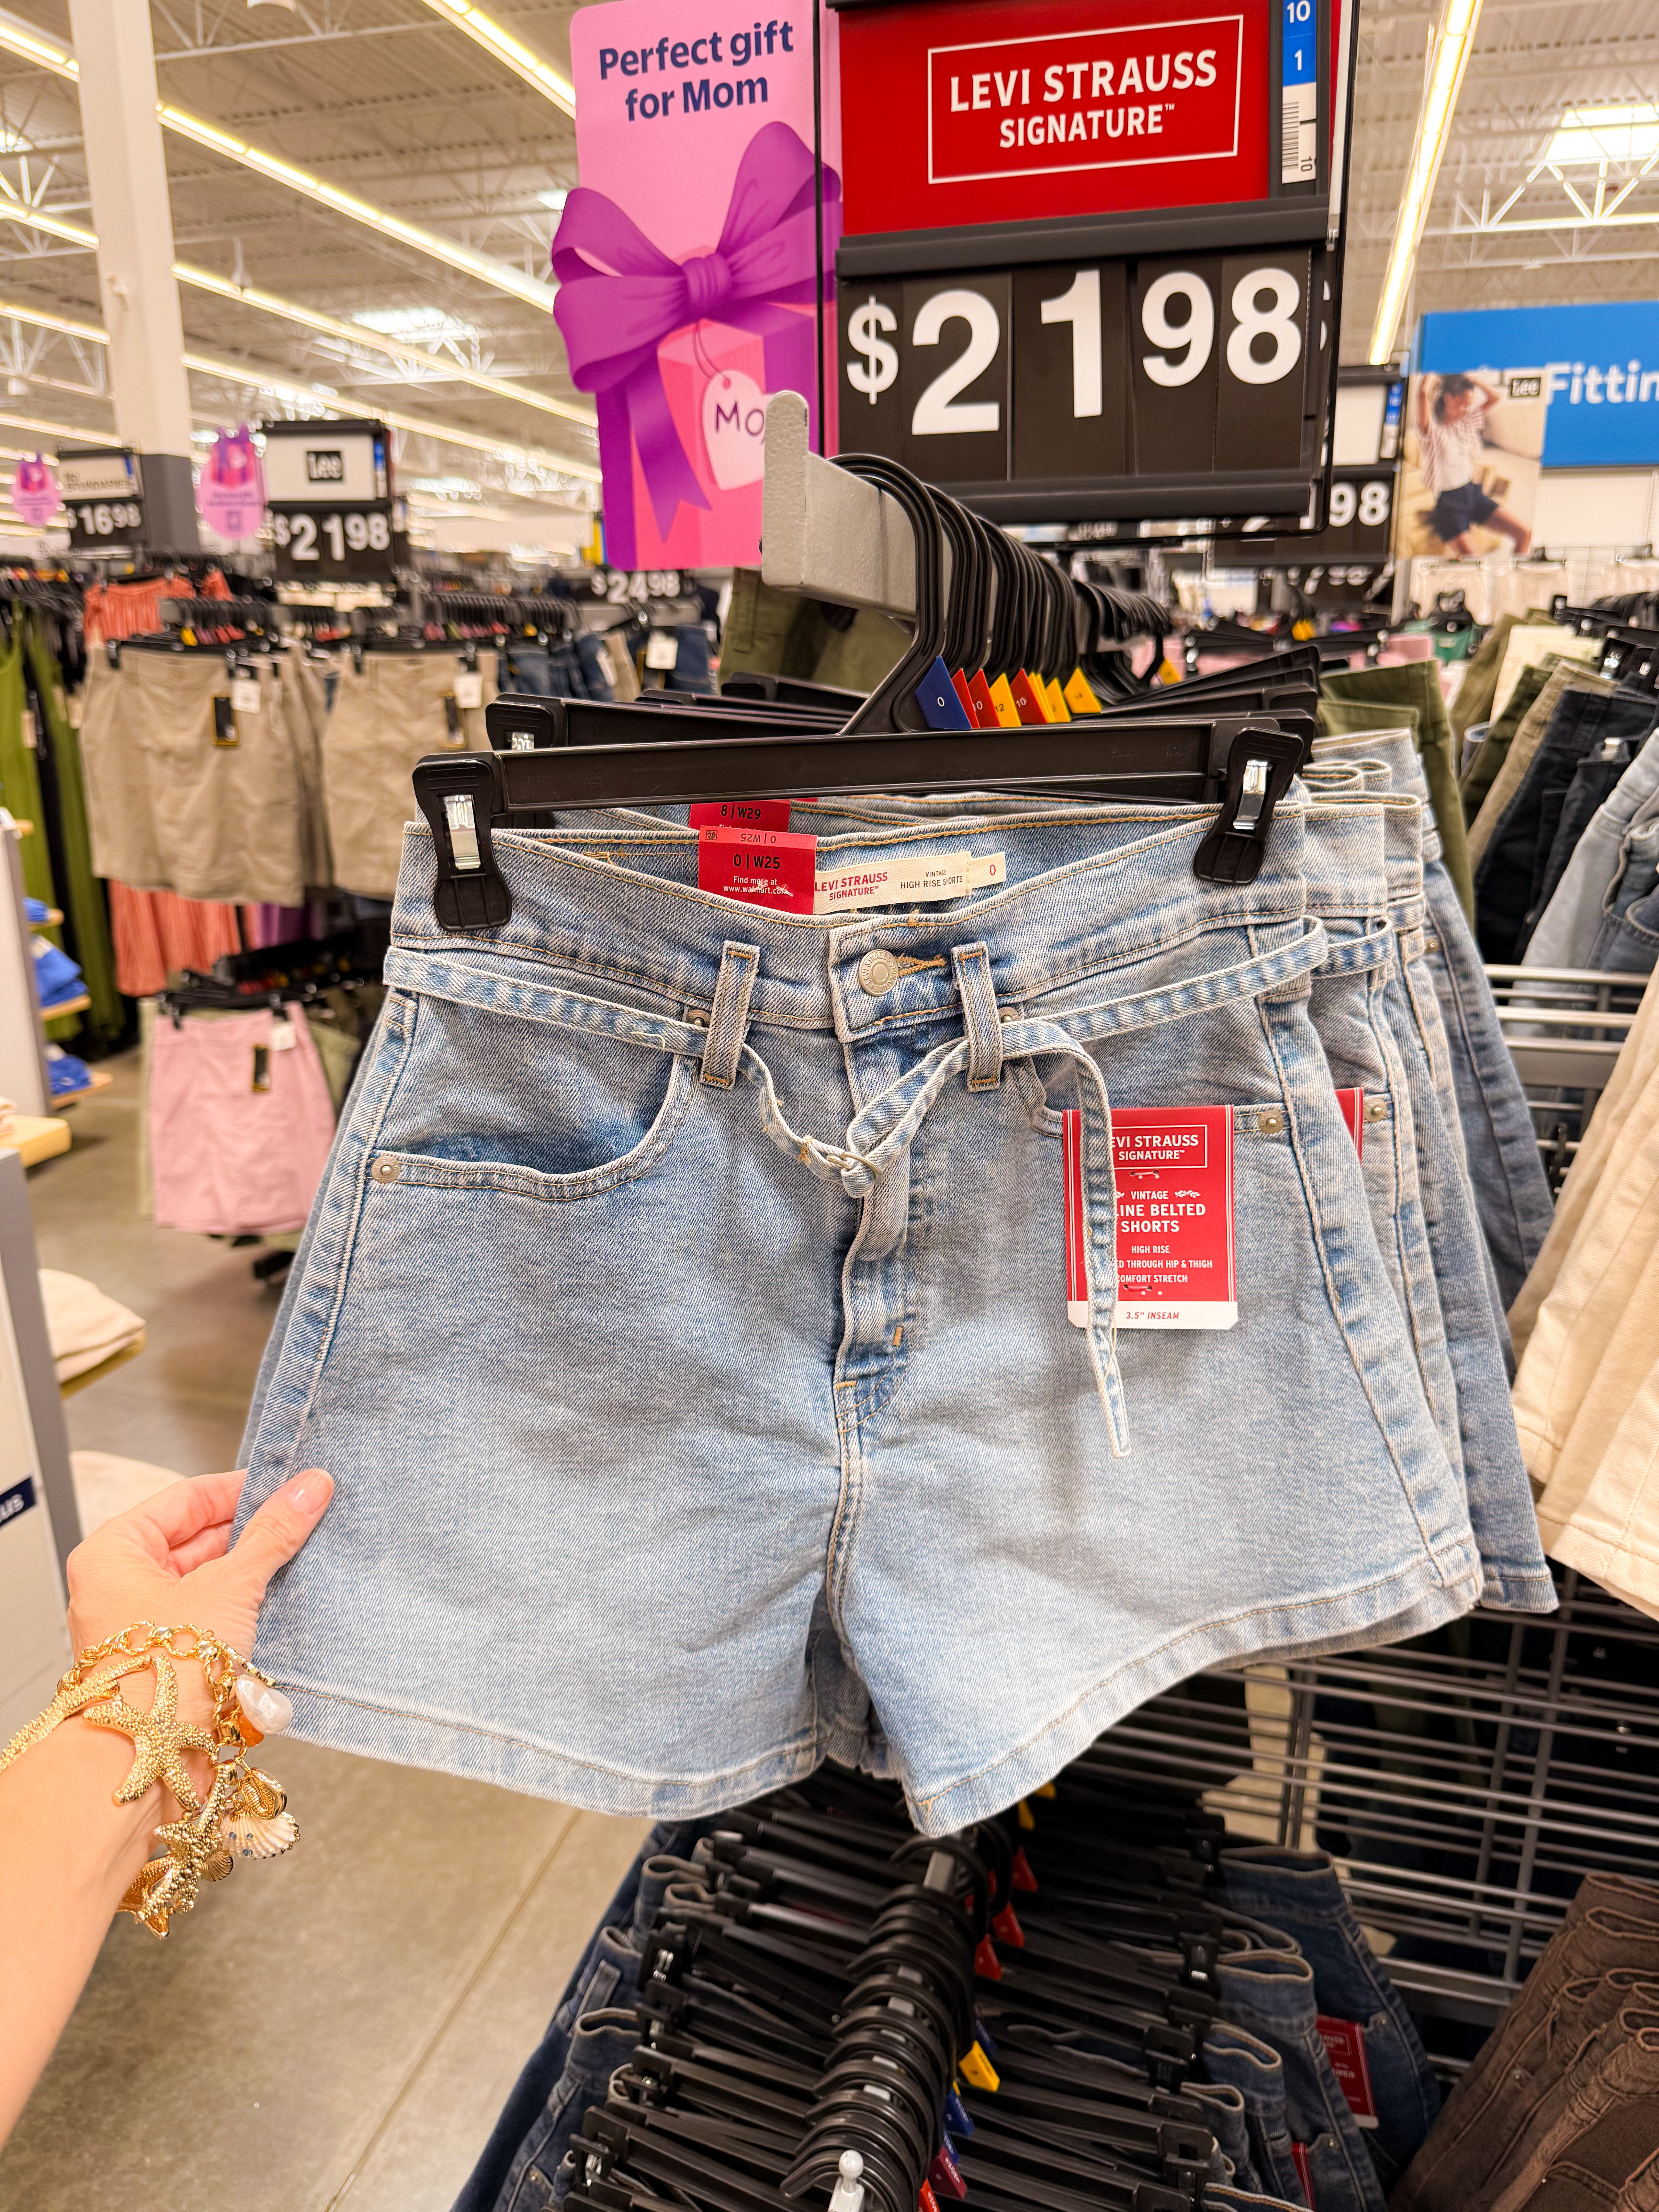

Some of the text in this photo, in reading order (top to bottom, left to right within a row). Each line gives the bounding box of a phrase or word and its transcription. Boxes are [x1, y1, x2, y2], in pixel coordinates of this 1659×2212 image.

[1287, 0, 1310, 23] 10
[599, 20, 793, 79] Perfect gift
[1295, 50, 1302, 71] 1
[950, 50, 1217, 112] LEVI STRAUSS
[625, 77, 768, 121] for Mom
[1300, 156, 1313, 172] 10
[1546, 359, 1659, 405] Fittin
[937, 697, 945, 707] 0
[995, 704, 1005, 713] 12
[1016, 697, 1027, 708] 10
[721, 805, 727, 816] 8
[738, 807, 761, 820] W29
[734, 854, 742, 867] 0
[754, 855, 780, 869] W25
[990, 864, 996, 876] 0
[815, 872, 888, 891] LEVI STRAUSS
[901, 881, 920, 889] HIGH
[943, 876, 963, 886] SHORTS
[723, 886, 787, 895] www.walart.co
[1111, 1135, 1199, 1147] EVI STRAUSS
[1131, 1191, 1169, 1200] VINTAGE
[1117, 1204, 1206, 1216] INE BELTED
[1121, 1220, 1180, 1233] SHORTS
[1131, 1245, 1170, 1254] HIGH RISE
[1127, 1260, 1163, 1268] THROUGH
[1166, 1260, 1179, 1268] HIP
[1181, 1260, 1187, 1268] &
[1188, 1260, 1213, 1268] THIGH
[1154, 1274, 1188, 1283] STRETCH
